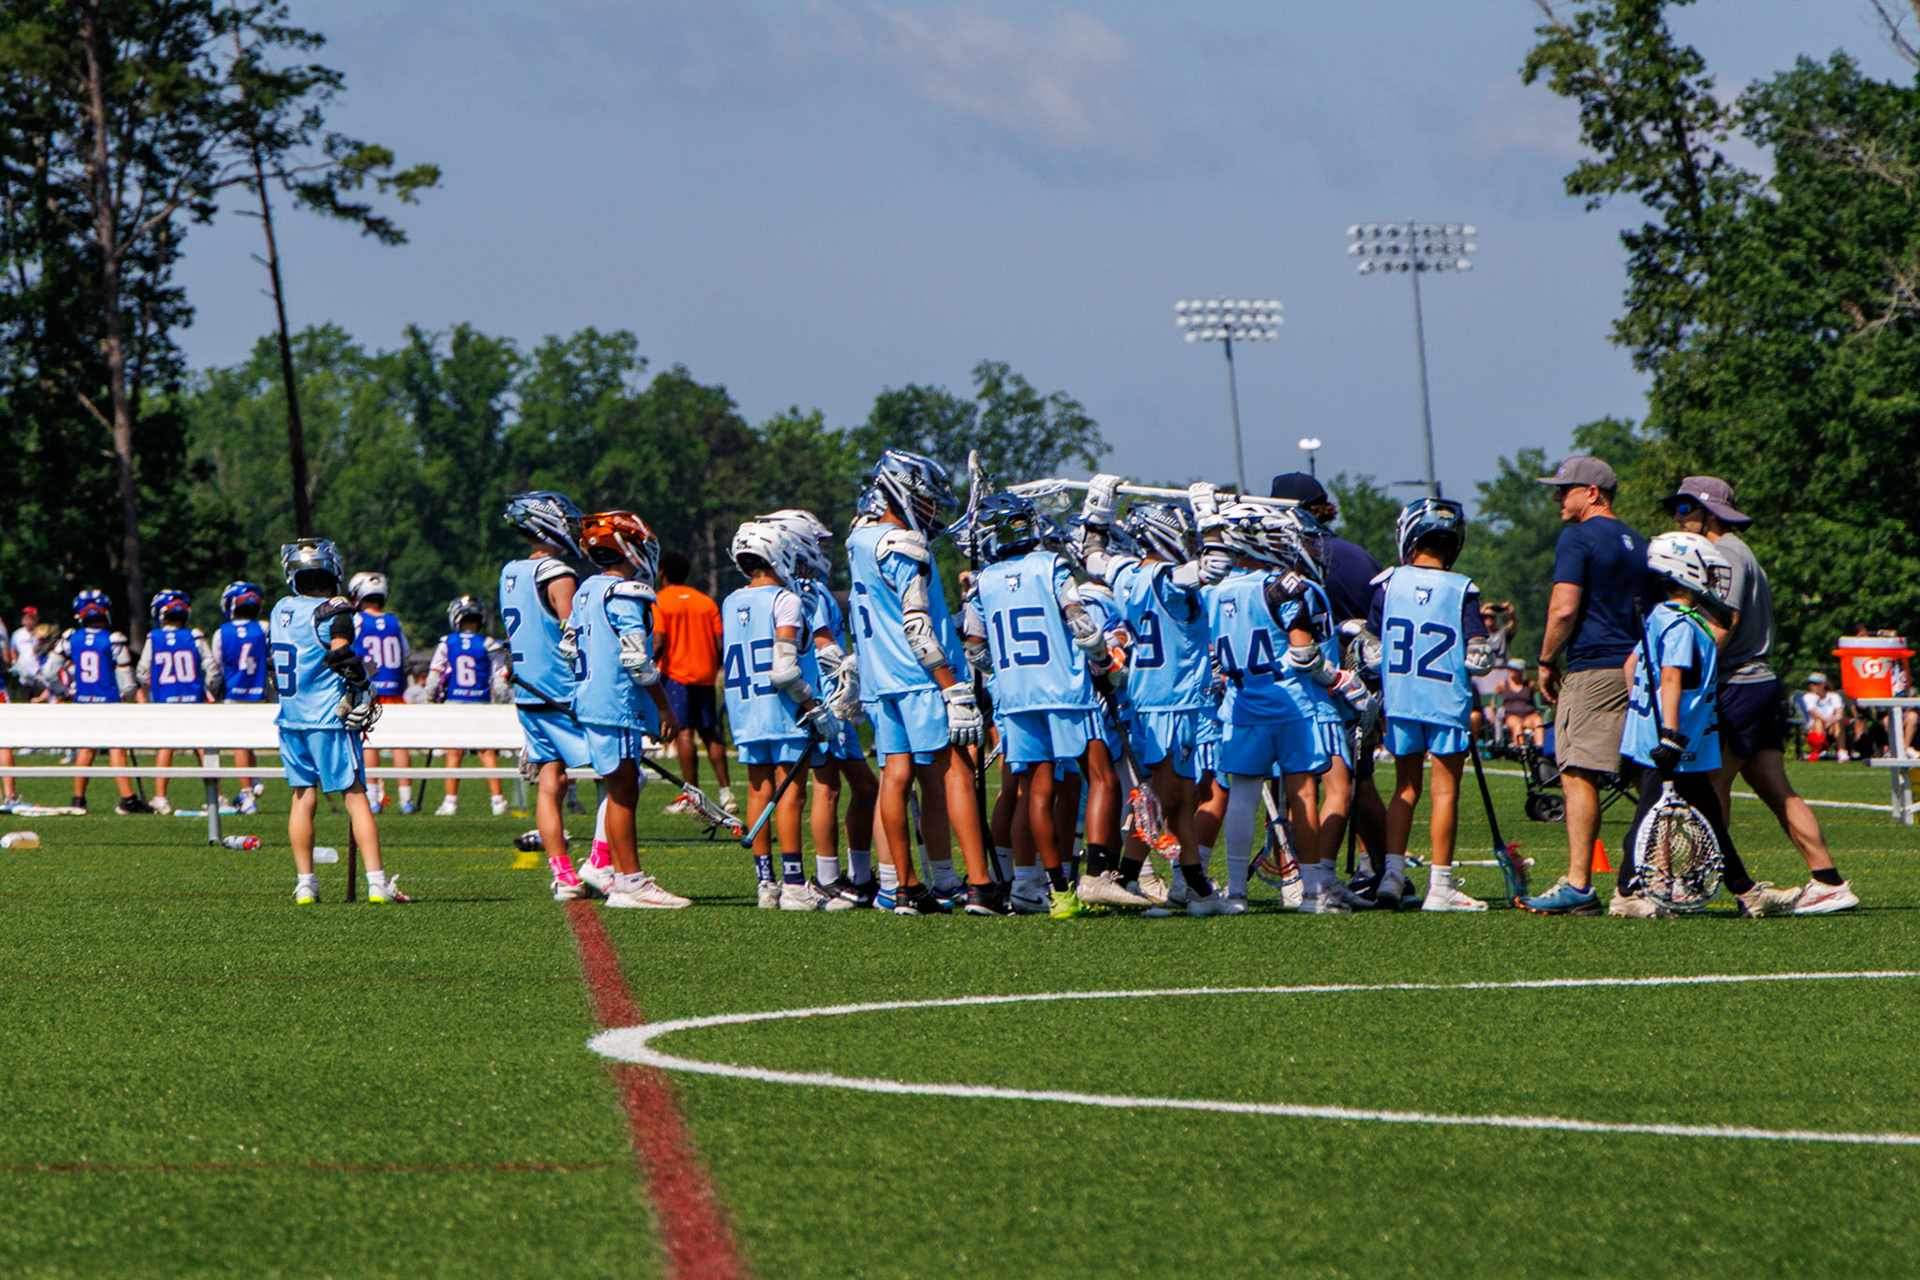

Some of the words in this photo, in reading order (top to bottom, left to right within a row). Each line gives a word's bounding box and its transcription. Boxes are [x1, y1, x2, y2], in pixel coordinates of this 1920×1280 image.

[362, 635, 401, 670] 30
[992, 607, 1051, 670] 15
[1385, 616, 1458, 684] 32
[80, 651, 99, 683] 9
[155, 650, 196, 684] 20
[238, 643, 257, 675] 4
[455, 655, 477, 687] 6
[723, 638, 778, 700] 45
[1216, 627, 1284, 690] 44
